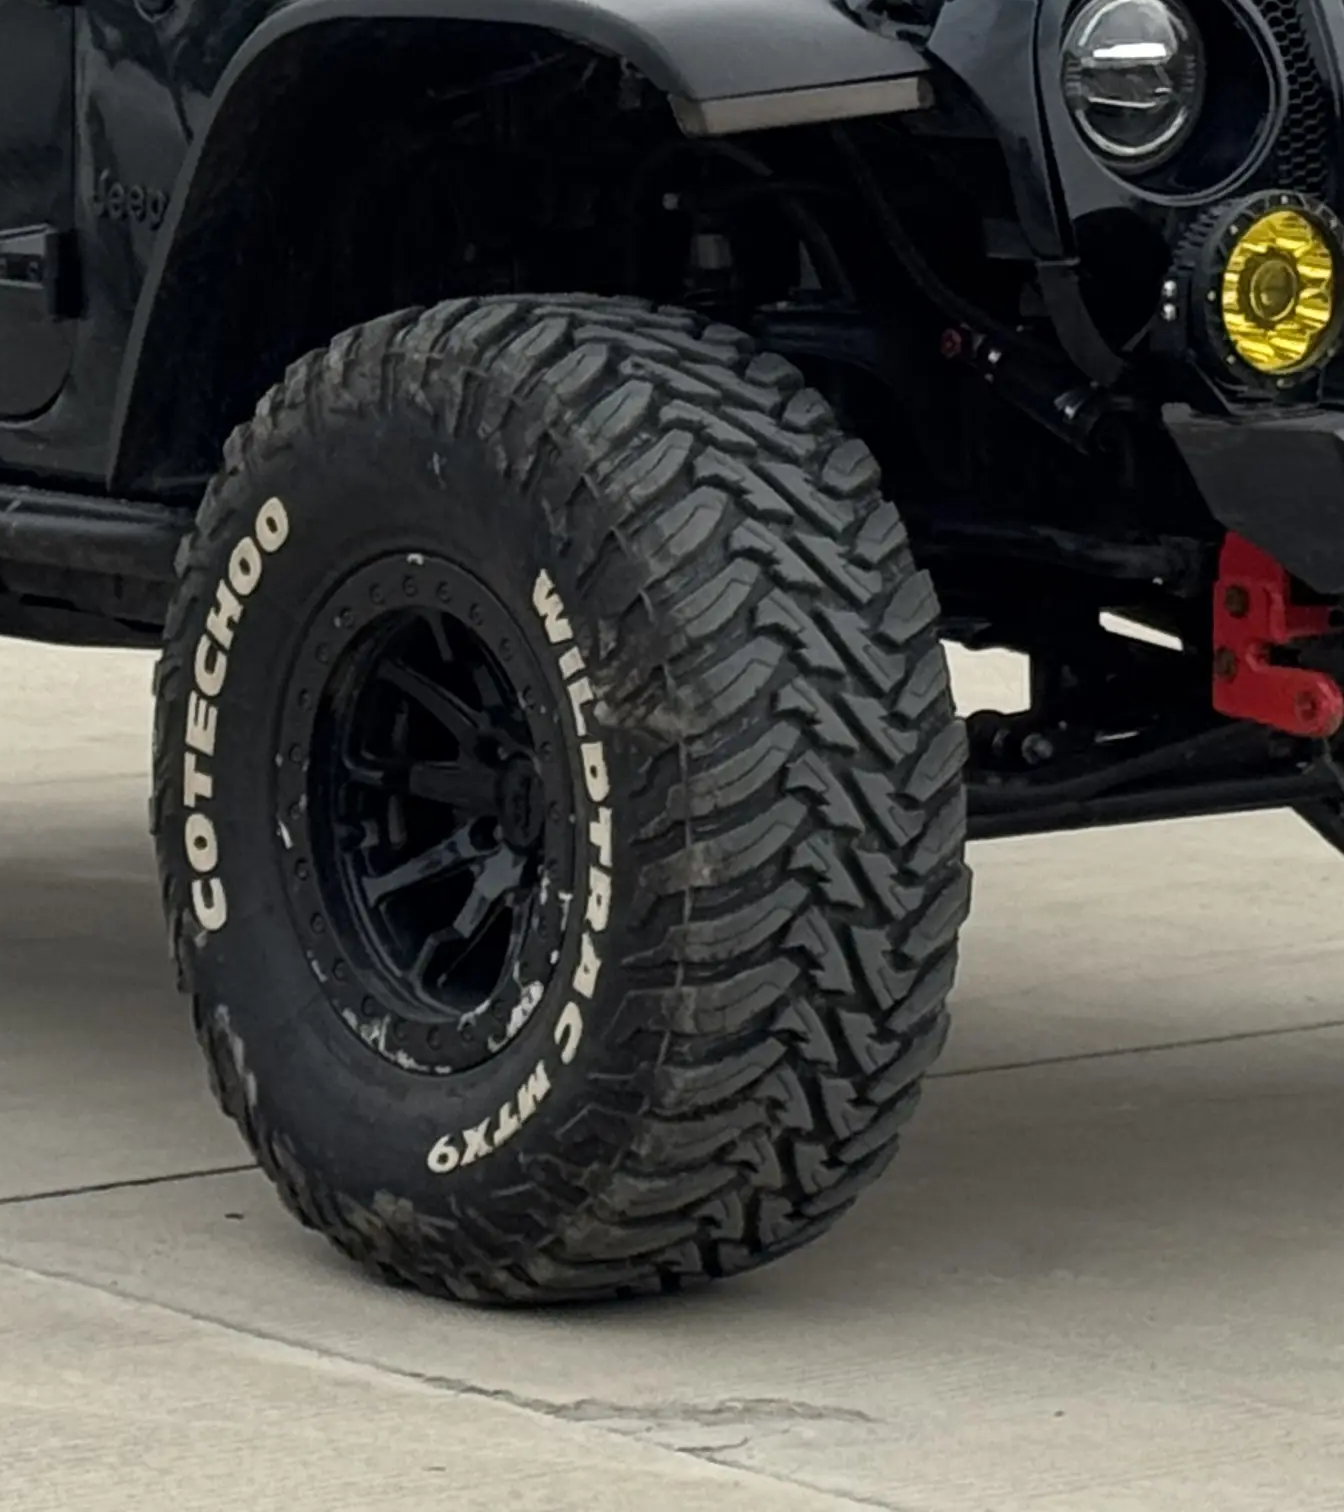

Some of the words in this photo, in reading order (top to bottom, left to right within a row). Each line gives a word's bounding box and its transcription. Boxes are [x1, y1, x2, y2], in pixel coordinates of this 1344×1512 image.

[92, 168, 167, 227] Jeep
[183, 496, 289, 931] COTECHOO
[532, 568, 613, 1065] WILDTRAC
[426, 1061, 552, 1174] MTX9
